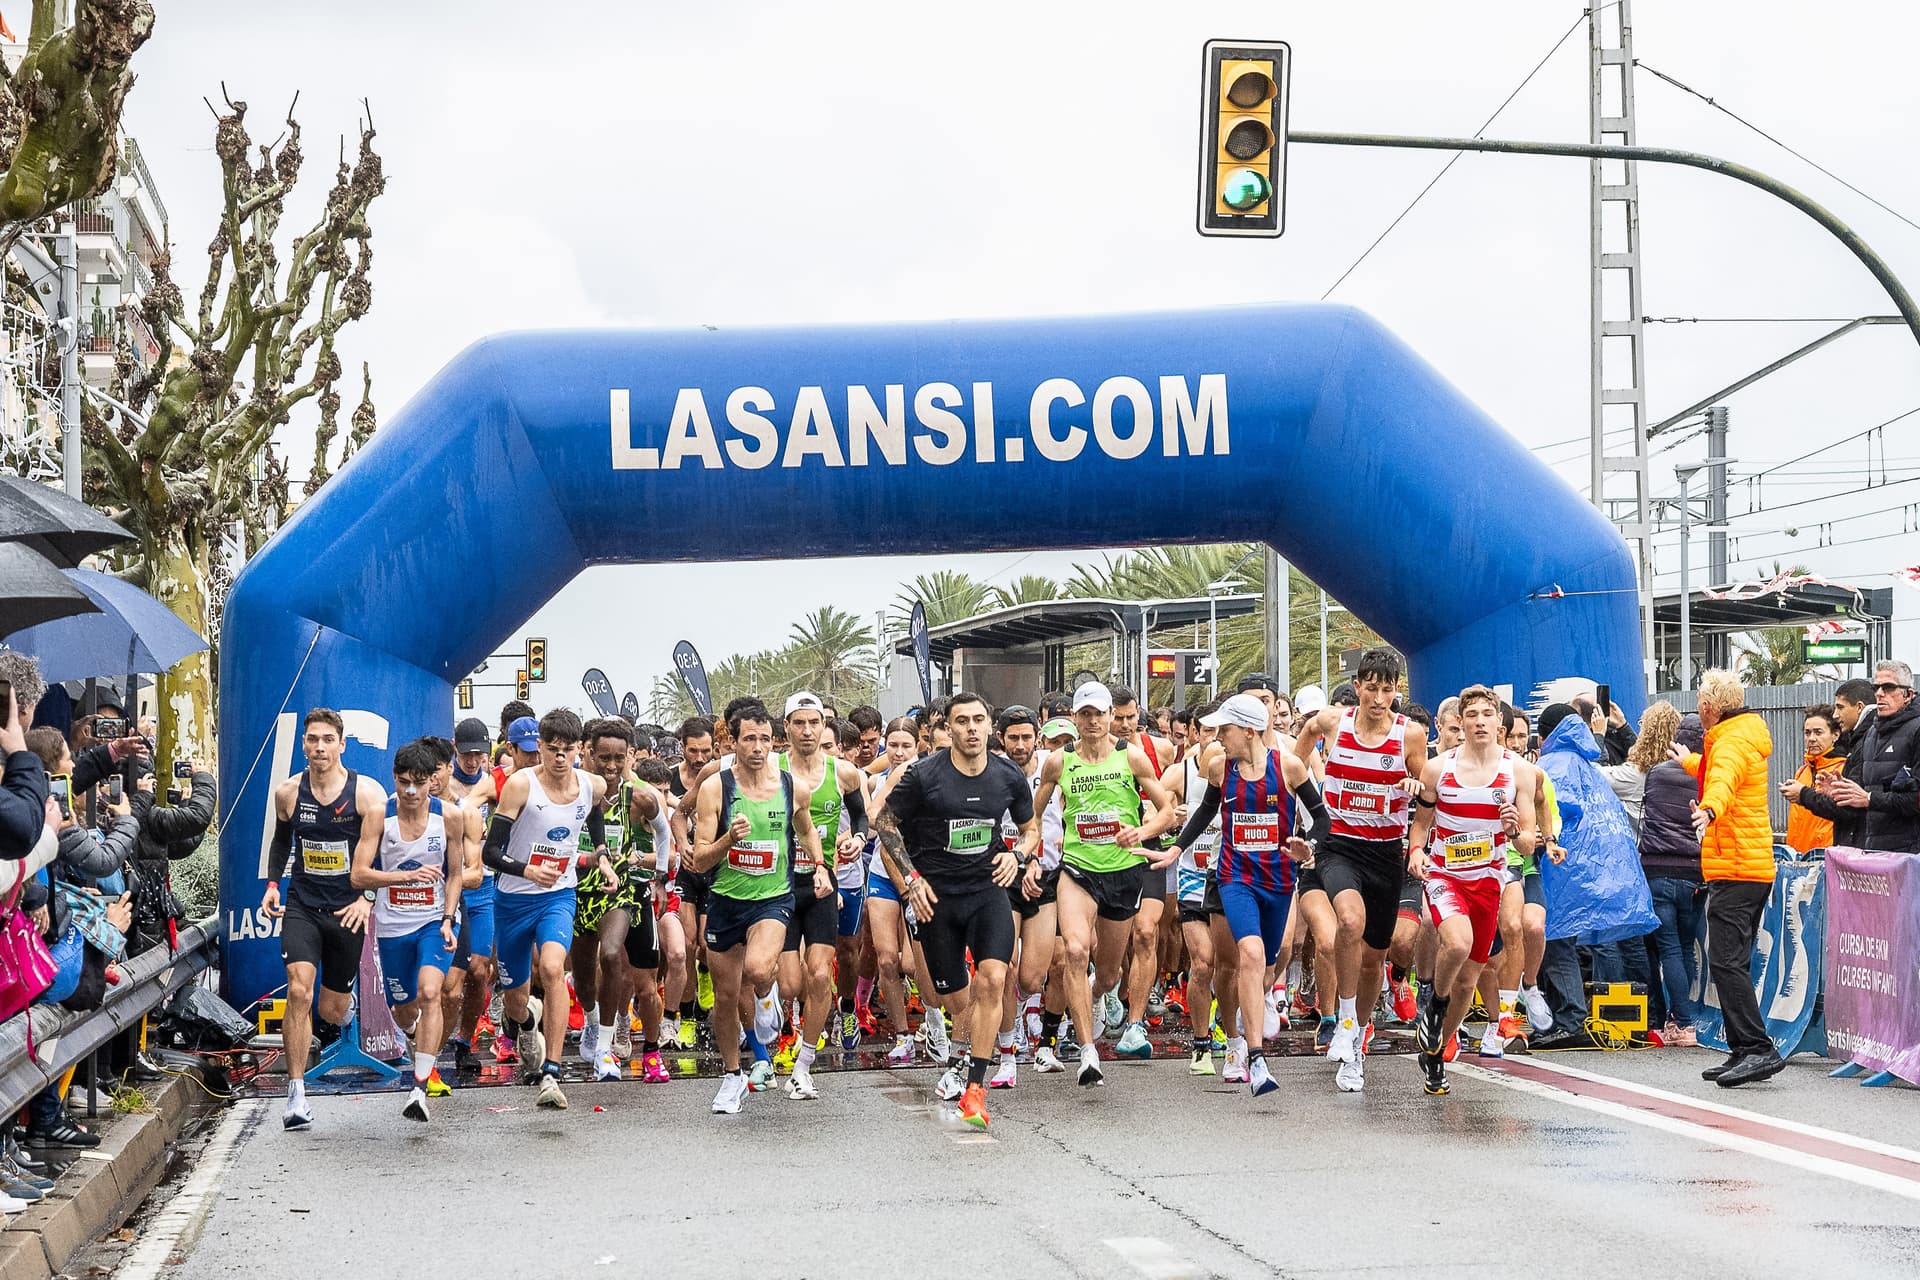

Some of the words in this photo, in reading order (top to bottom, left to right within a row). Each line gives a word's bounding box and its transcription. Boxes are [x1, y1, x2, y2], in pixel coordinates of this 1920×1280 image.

[610, 374, 1230, 470] LASANSI.COM
[1193, 666, 1206, 683] 2
[1071, 772, 1122, 785] LASANSI.COM
[1070, 784, 1094, 794] B100
[1349, 796, 1376, 809] JORDI
[1234, 815, 1257, 824] LASANSI
[962, 831, 982, 844] FRAN
[1244, 829, 1269, 839] HUGO
[1455, 846, 1482, 858] ROGER
[308, 855, 338, 865] ROBERTS
[738, 854, 764, 865] DAVID
[396, 892, 428, 901] MARCEL
[1839, 933, 1866, 957] CURSA
[1866, 936, 1875, 959] DE
[1841, 965, 1872, 991] CURSES
